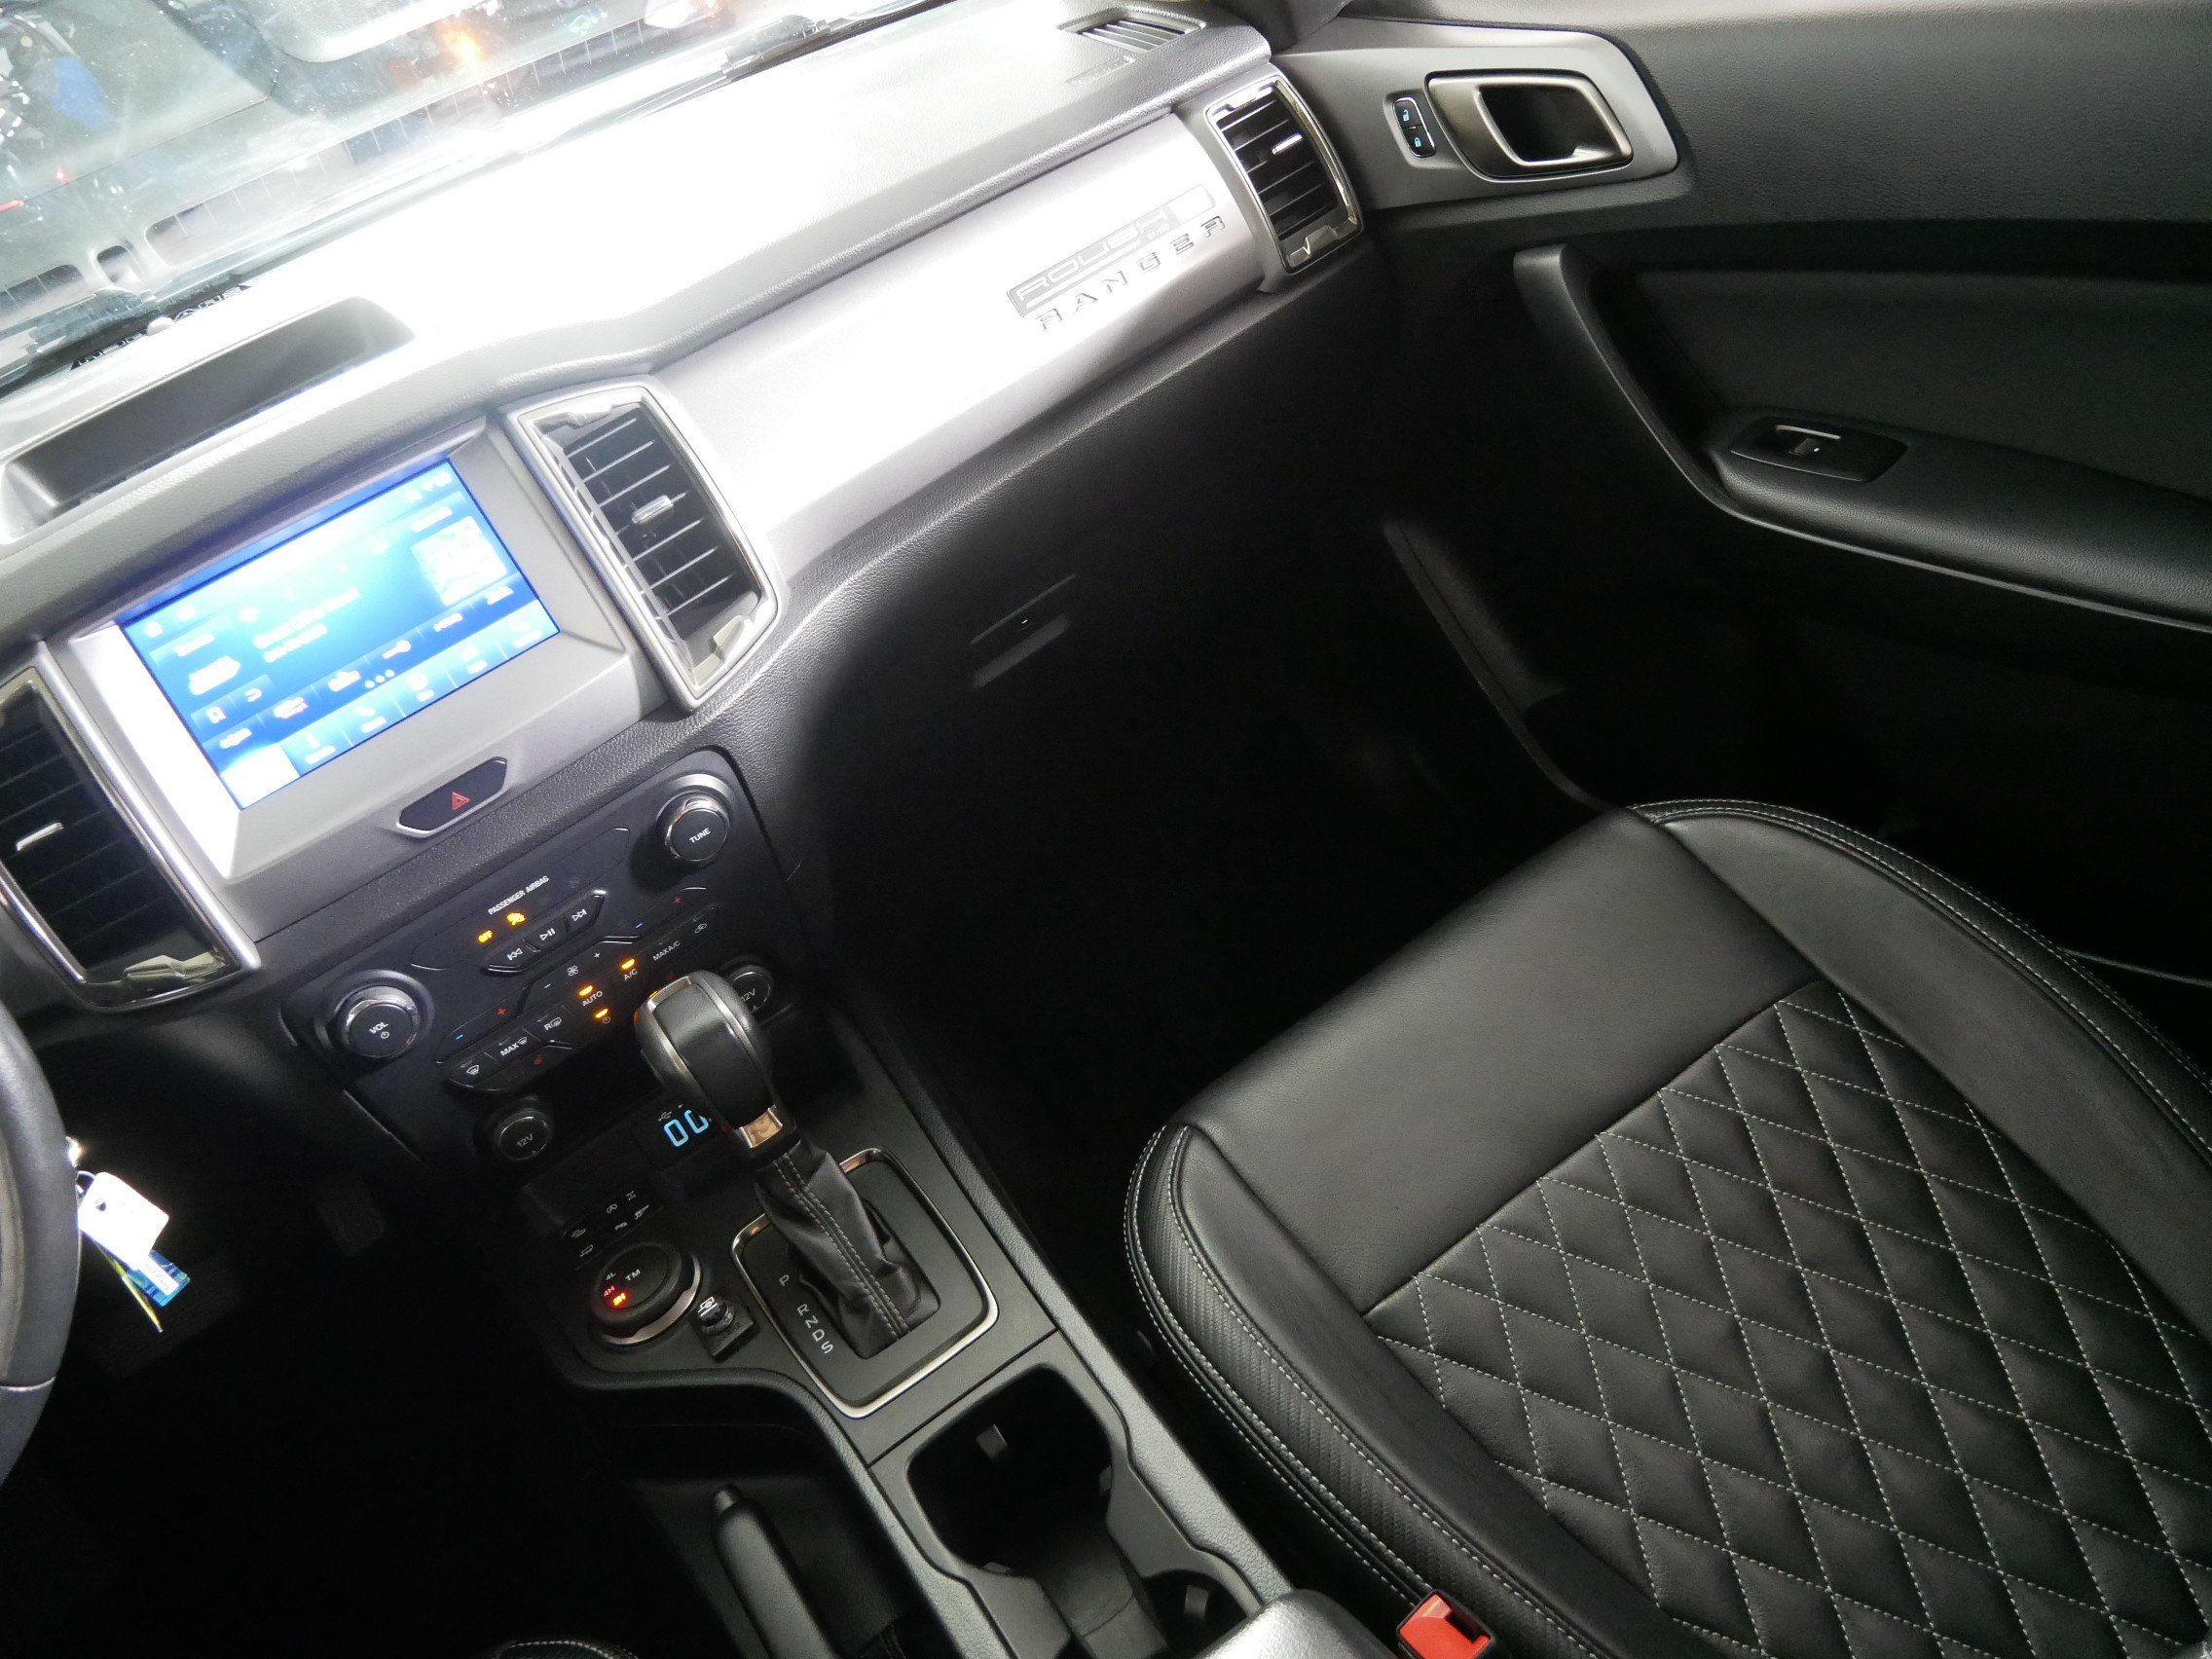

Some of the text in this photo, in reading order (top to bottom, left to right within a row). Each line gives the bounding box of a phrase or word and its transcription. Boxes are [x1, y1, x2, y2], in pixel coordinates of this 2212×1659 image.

[1016, 208, 1167, 301] ROUSH
[1034, 215, 1226, 332] RANGER
[689, 828, 711, 843] TUNE
[488, 875, 549, 914] PASSENGER AIRBAG
[652, 940, 681, 962] MAX A/C
[623, 968, 638, 981] A/C
[582, 990, 604, 1007] AUTO
[740, 987, 756, 1002] 12V
[369, 1021, 388, 1034] VOL
[499, 1042, 519, 1056] MAX
[516, 1133, 535, 1148] 12V
[606, 1272, 616, 1281] 4L
[624, 1269, 641, 1281] TM
[604, 1285, 615, 1297] 4H
[779, 1274, 833, 1354] P R N D S
